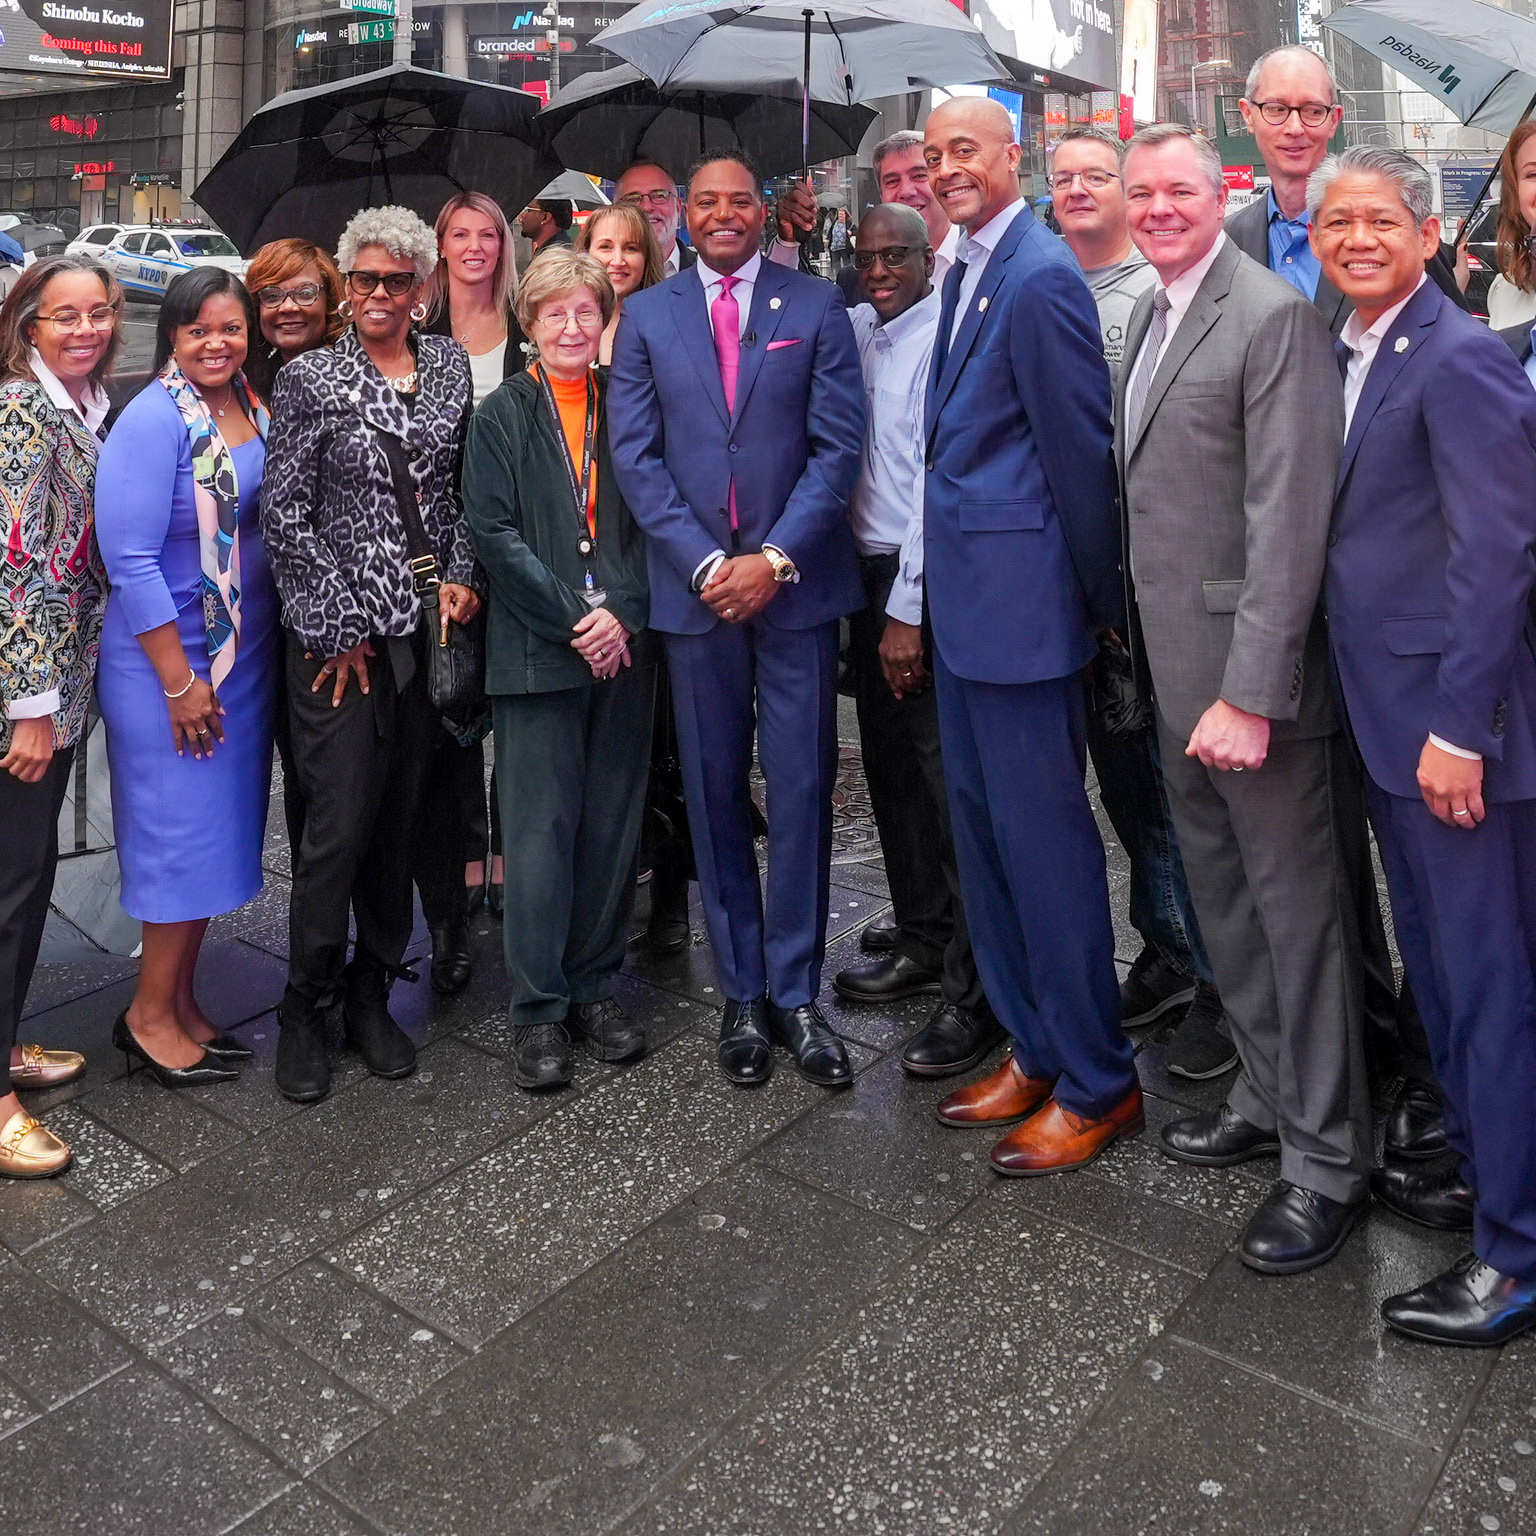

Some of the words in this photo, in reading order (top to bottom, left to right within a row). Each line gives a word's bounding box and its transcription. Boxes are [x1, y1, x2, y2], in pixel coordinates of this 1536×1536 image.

[43, 2, 100, 23] Shinobu
[102, 10, 144, 27] Kocho
[304, 31, 327, 43] Nasdaq
[360, 25, 369, 40] W
[373, 23, 385, 40] 43
[41, 33, 93, 54] Coming
[94, 39, 118, 54] this
[120, 42, 142, 56] Fall
[138, 265, 160, 283] NYPD
